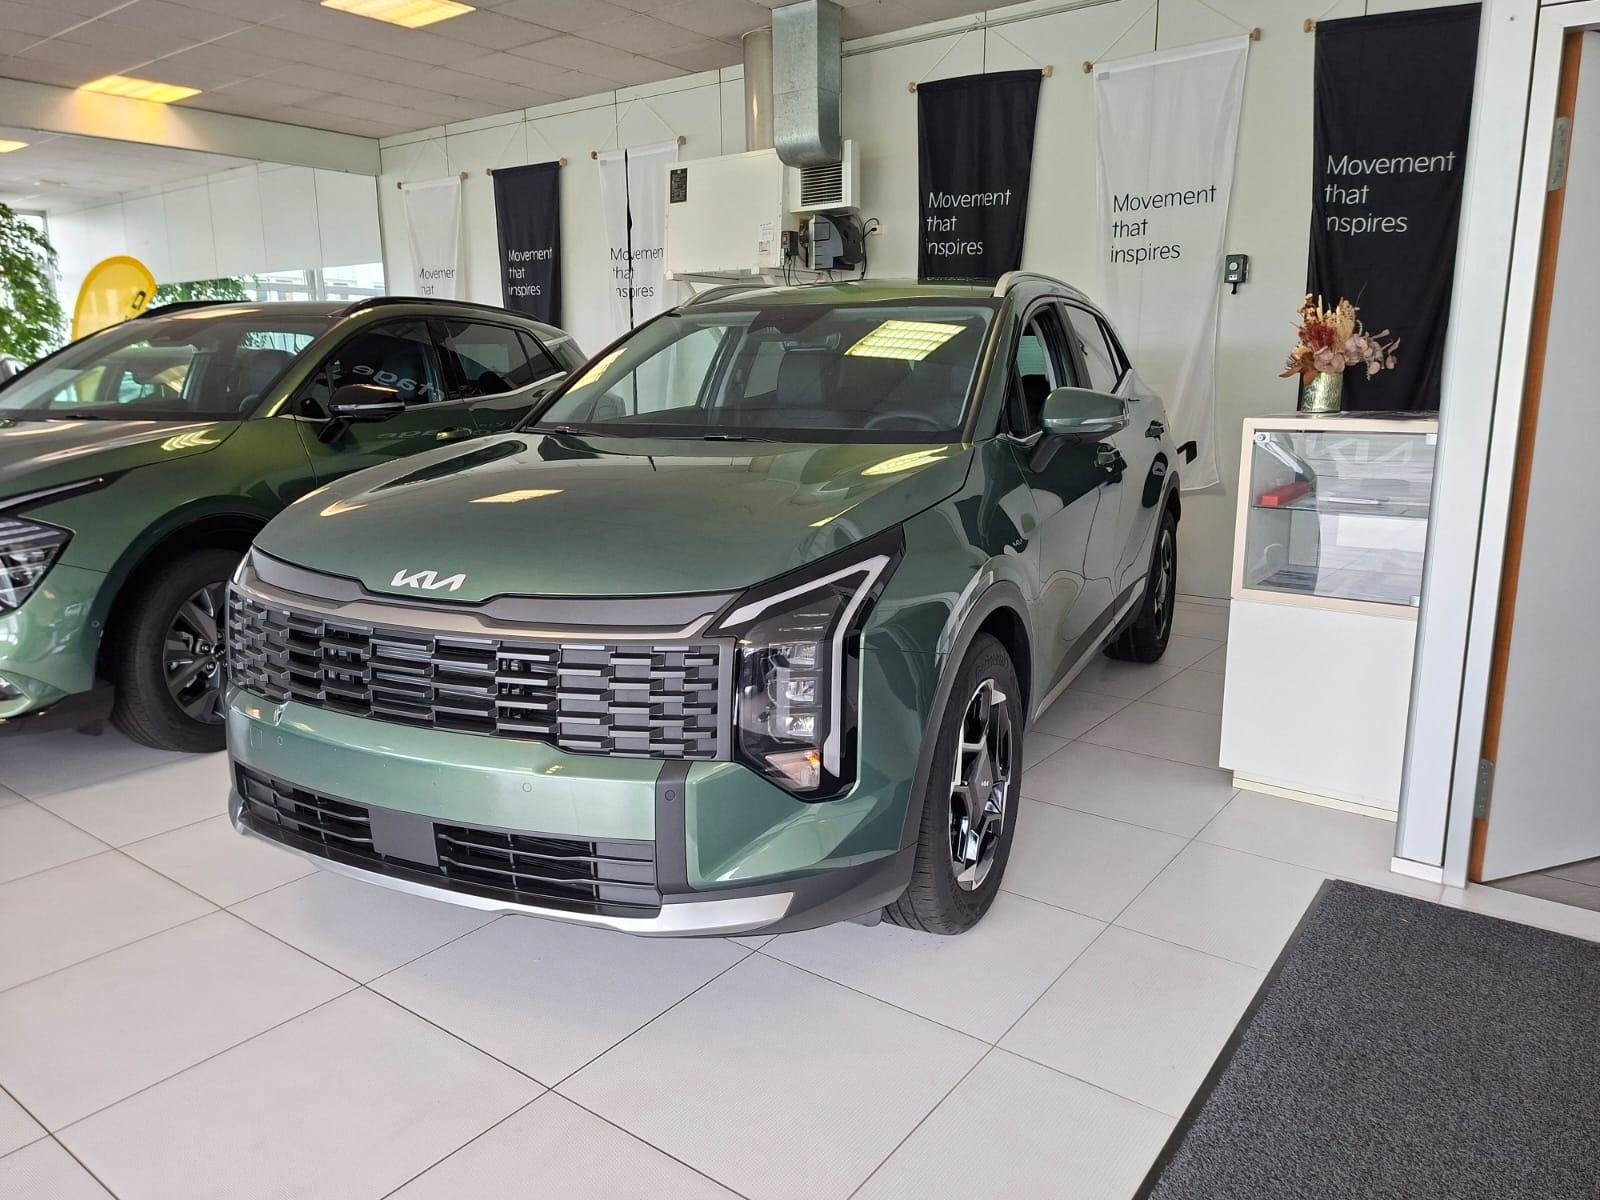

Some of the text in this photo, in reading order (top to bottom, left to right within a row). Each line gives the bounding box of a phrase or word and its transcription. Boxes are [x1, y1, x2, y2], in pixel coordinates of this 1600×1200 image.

[1326, 151, 1456, 175] Movement
[928, 189, 1011, 208] Movement
[1113, 185, 1216, 213] Movement
[1324, 184, 1370, 204] that
[926, 215, 957, 232] that
[1112, 218, 1148, 238] that
[1326, 213, 1408, 236] nspires
[508, 247, 552, 262] Movement
[610, 247, 664, 261] Movemen
[1110, 243, 1181, 264] inspires
[508, 266, 525, 279] that
[613, 266, 634, 279] hat
[508, 283, 541, 298] inspires
[616, 286, 655, 299] nspires
[390, 568, 466, 592] KIA
